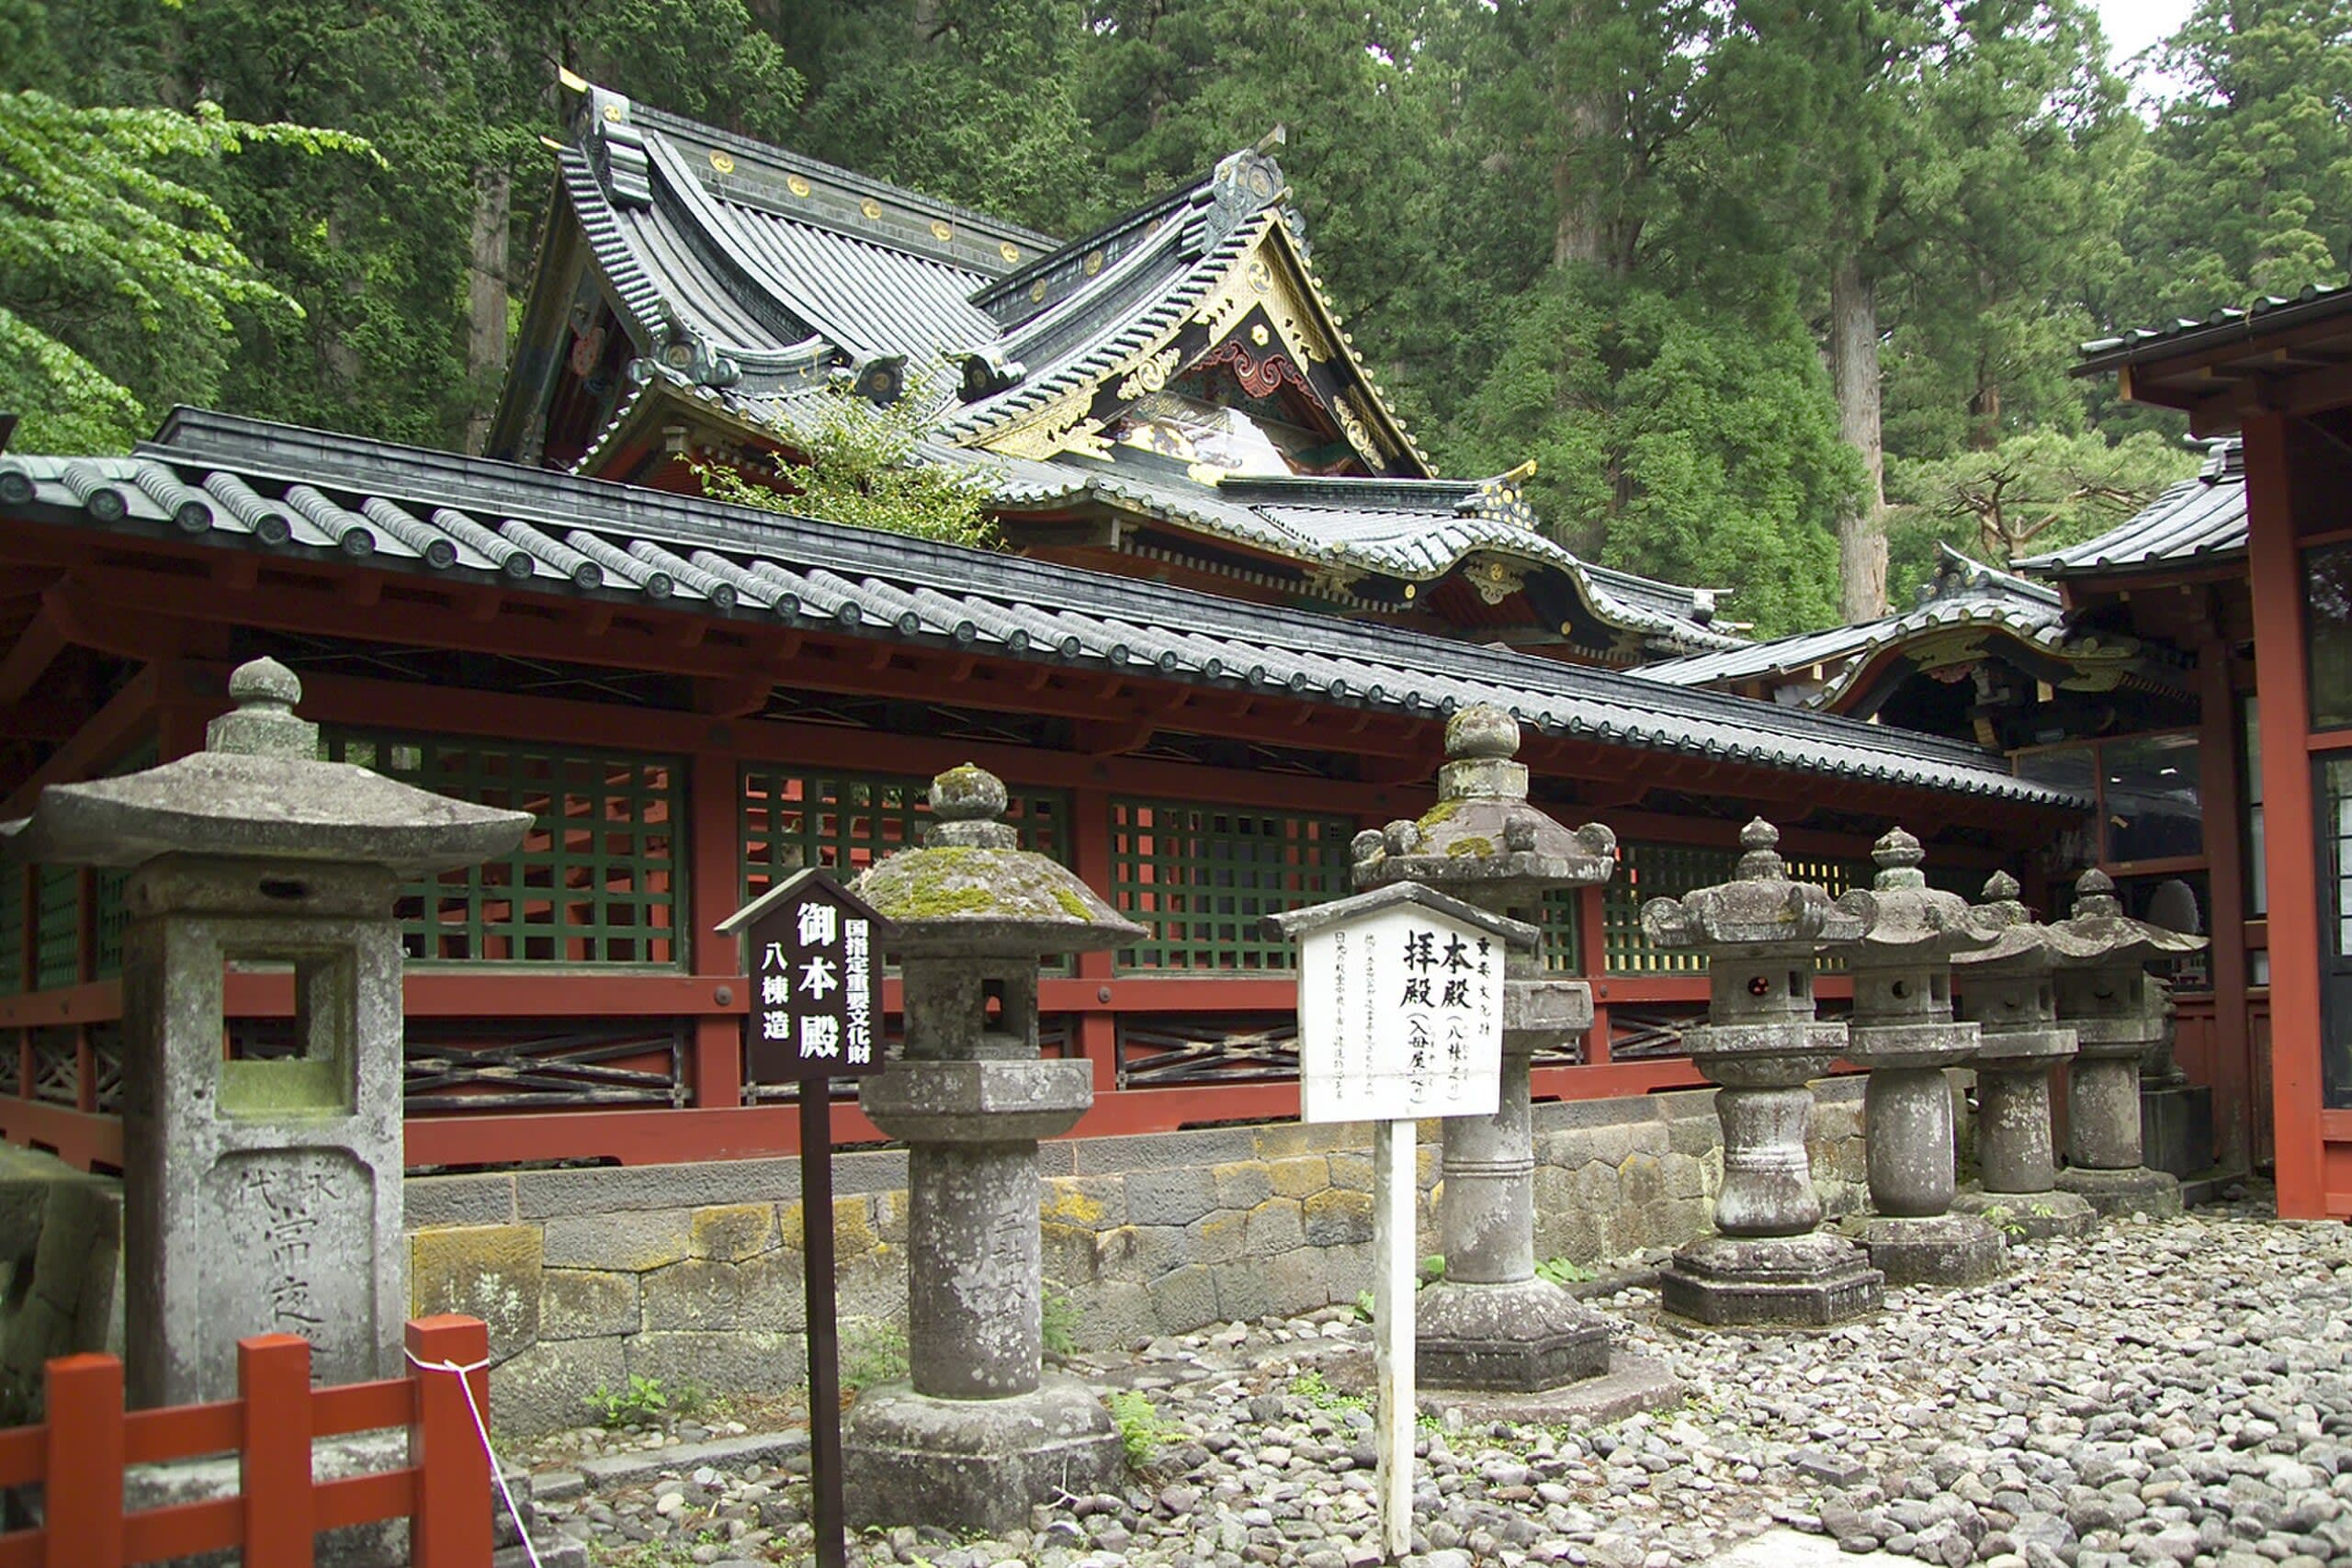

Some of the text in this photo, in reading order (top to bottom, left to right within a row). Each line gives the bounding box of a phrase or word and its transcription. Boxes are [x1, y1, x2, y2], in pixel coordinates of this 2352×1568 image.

[761, 942, 790, 1040] 八棟造
[797, 902, 839, 1059] 御本殿
[844, 919, 871, 1064] 国指定重要文化財
[1476, 936, 1493, 1036] 重要文化財
